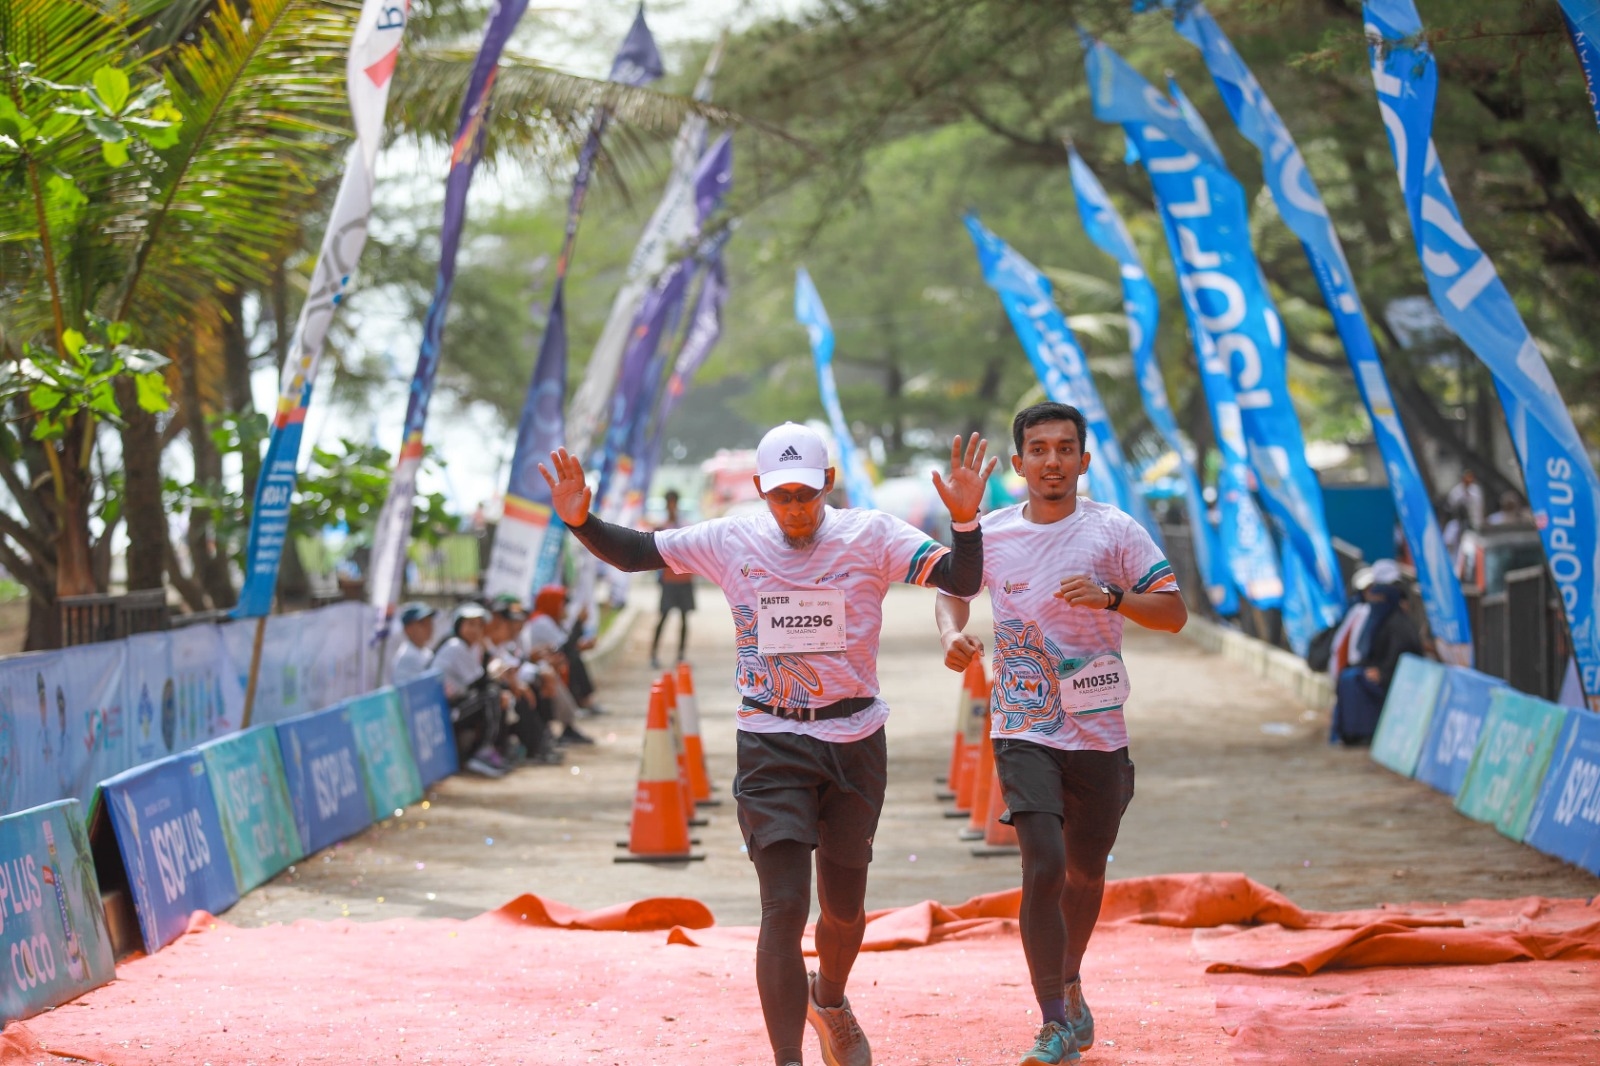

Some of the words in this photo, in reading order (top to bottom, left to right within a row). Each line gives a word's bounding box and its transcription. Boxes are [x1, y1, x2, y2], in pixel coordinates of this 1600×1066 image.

[779, 454, 802, 462] adidas
[1547, 457, 1582, 622] SOPLUS
[760, 596, 790, 605] MASTER
[771, 614, 833, 628] M22296
[1063, 662, 1075, 670] 10K
[1072, 672, 1120, 690] M10353
[1554, 756, 1600, 827] ISOPLU
[150, 807, 211, 905] ISOPLUS
[0, 854, 42, 935] PLUS
[11, 932, 56, 992] COCO
